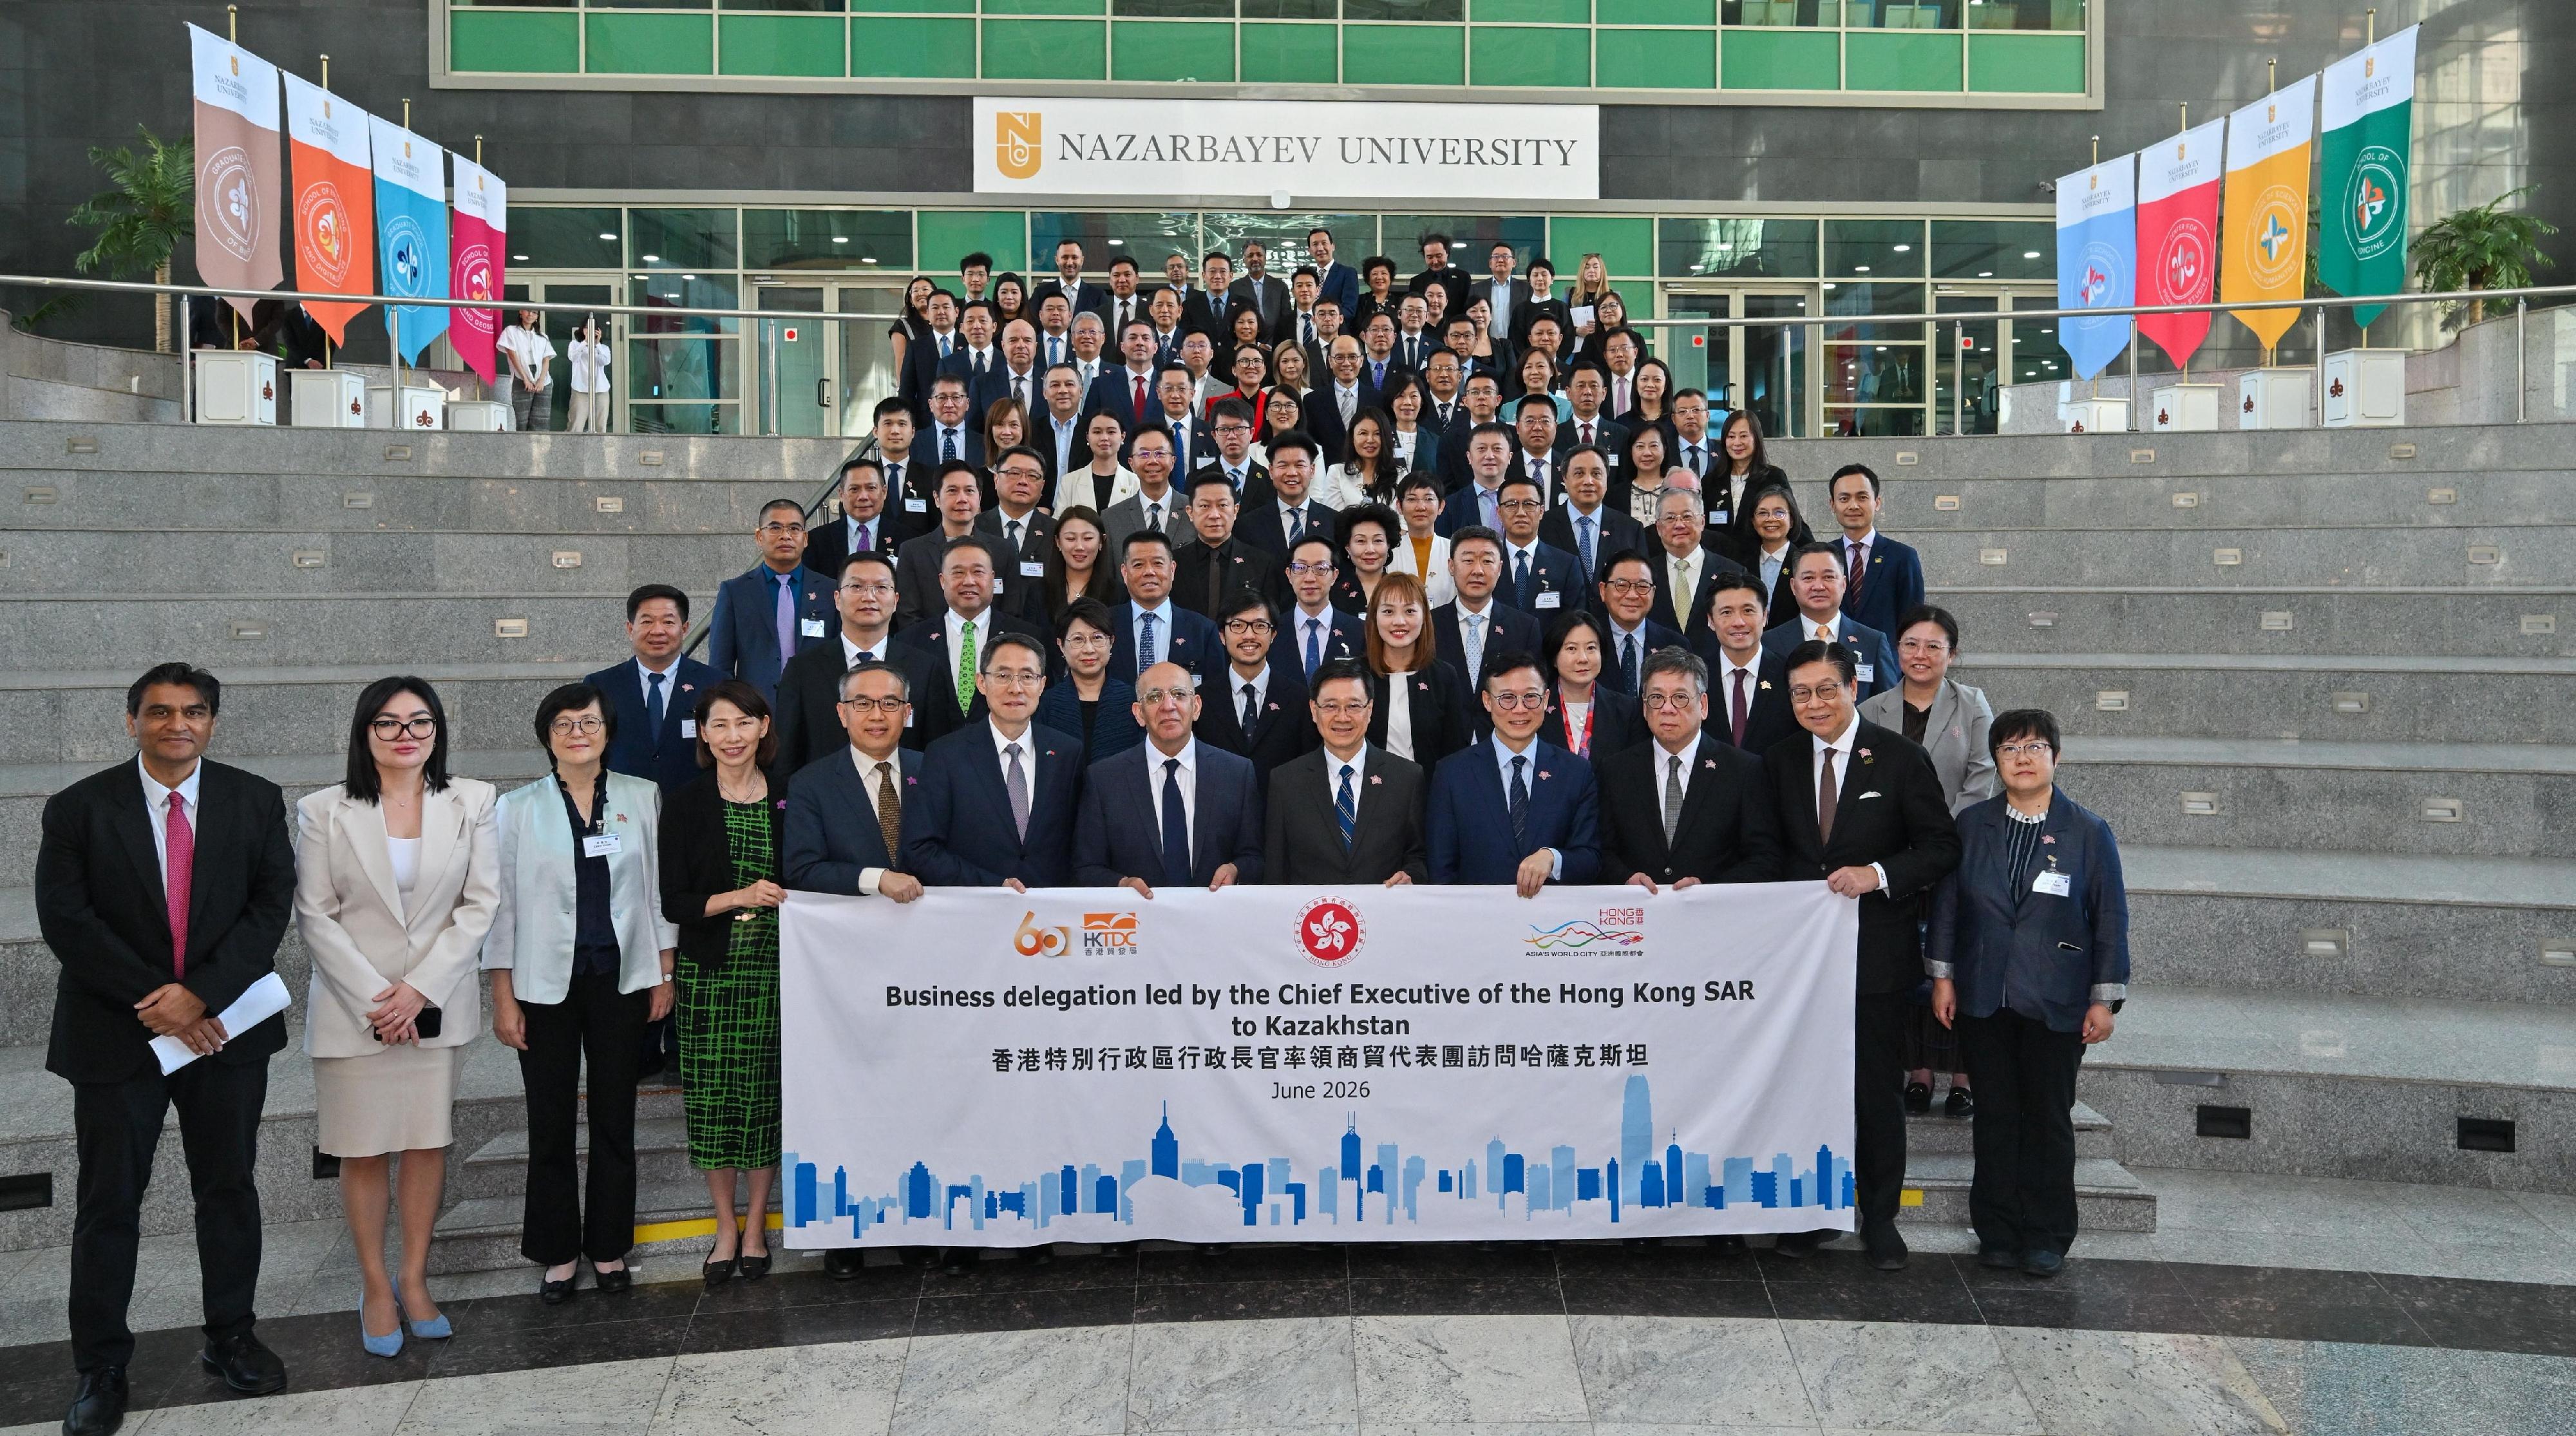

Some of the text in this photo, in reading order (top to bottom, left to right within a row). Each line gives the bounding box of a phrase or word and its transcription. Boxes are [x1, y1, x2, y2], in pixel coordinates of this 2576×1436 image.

[1059, 133, 1577, 167] NAZARBAYEV UNIVERSITY
[2378, 153, 2389, 162] OF
[211, 154, 243, 175] GRADUATE
[302, 190, 321, 216] SCHOOL
[2186, 223, 2197, 232] FOR
[227, 237, 238, 248] OF
[461, 250, 482, 267] SCHOOL
[1600, 917, 1634, 925] KONG
[1084, 932, 1137, 947] HKTDC
[1084, 947, 1137, 956] 香港貿發局
[1309, 955, 1352, 967] HONG KONG
[887, 981, 1755, 1011] Business delegation led by the Chief Executive of the Hong Kong SAR
[1232, 1015, 1410, 1036] to Kazakhstan
[992, 1044, 1649, 1073] 香港特別行政區行政長官率領商貿代表團訪問哈薩克斯坦
[1272, 1081, 1370, 1099] June 2026
